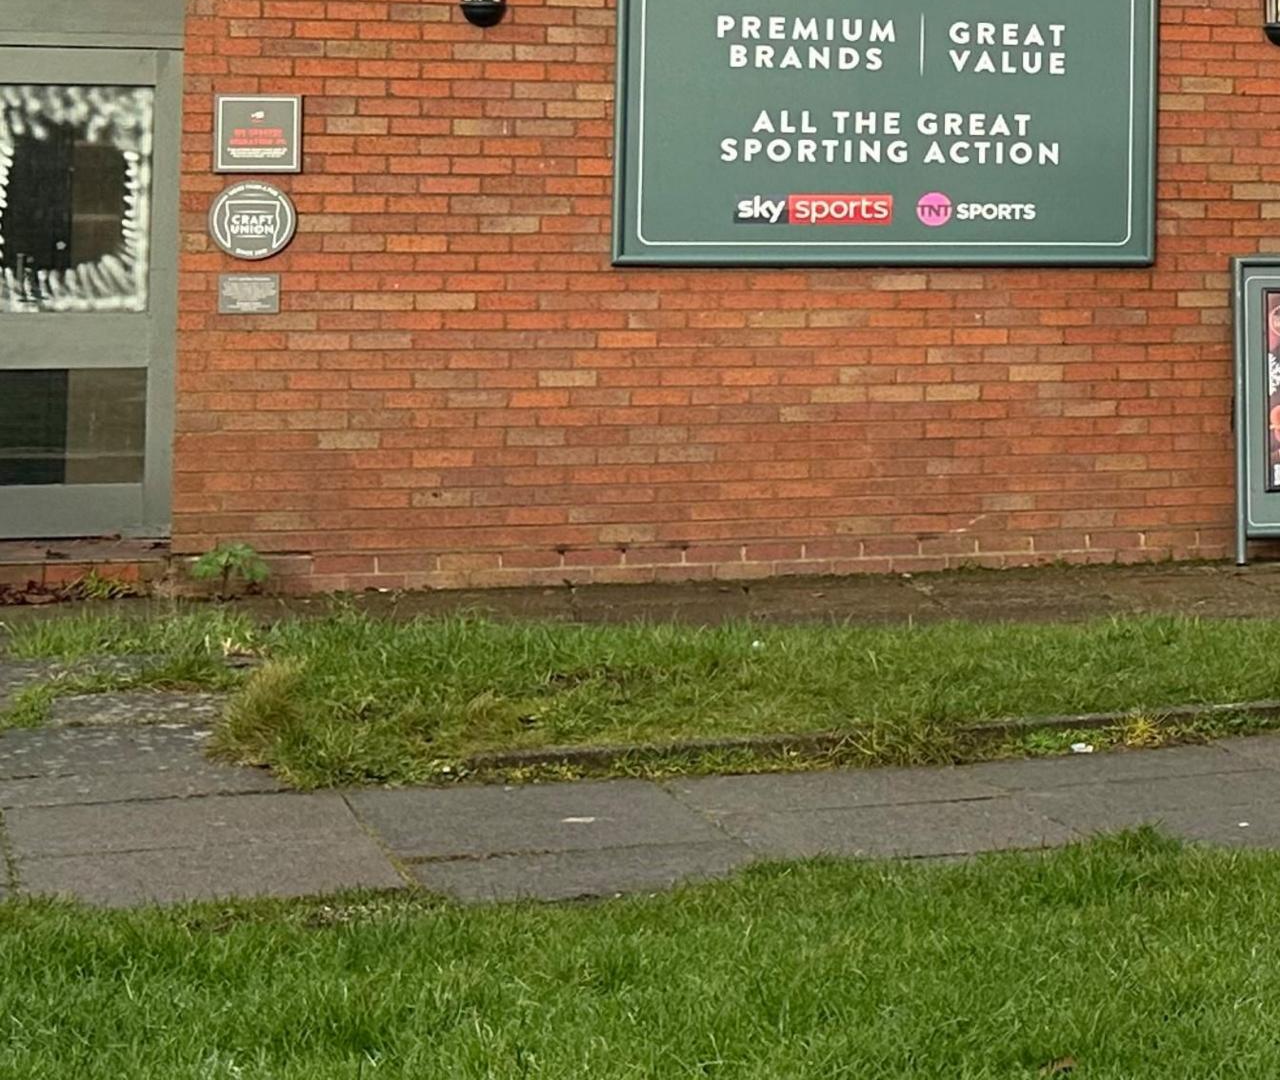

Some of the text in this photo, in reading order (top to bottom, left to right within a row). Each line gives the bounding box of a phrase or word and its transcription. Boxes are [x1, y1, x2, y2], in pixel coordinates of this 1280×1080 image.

[716, 15, 896, 43] PREMIUM
[949, 22, 1066, 47] GREAT
[729, 44, 883, 70] BRANDS
[949, 50, 1066, 75] VALUE
[752, 109, 1032, 137] ALL THE GREAT
[720, 138, 1060, 166] SPORTING ACTION
[231, 214, 274, 224] CRAFT
[737, 195, 889, 224] sky sports
[917, 203, 1036, 220] TNT SPORTS
[230, 224, 274, 235] UNION
